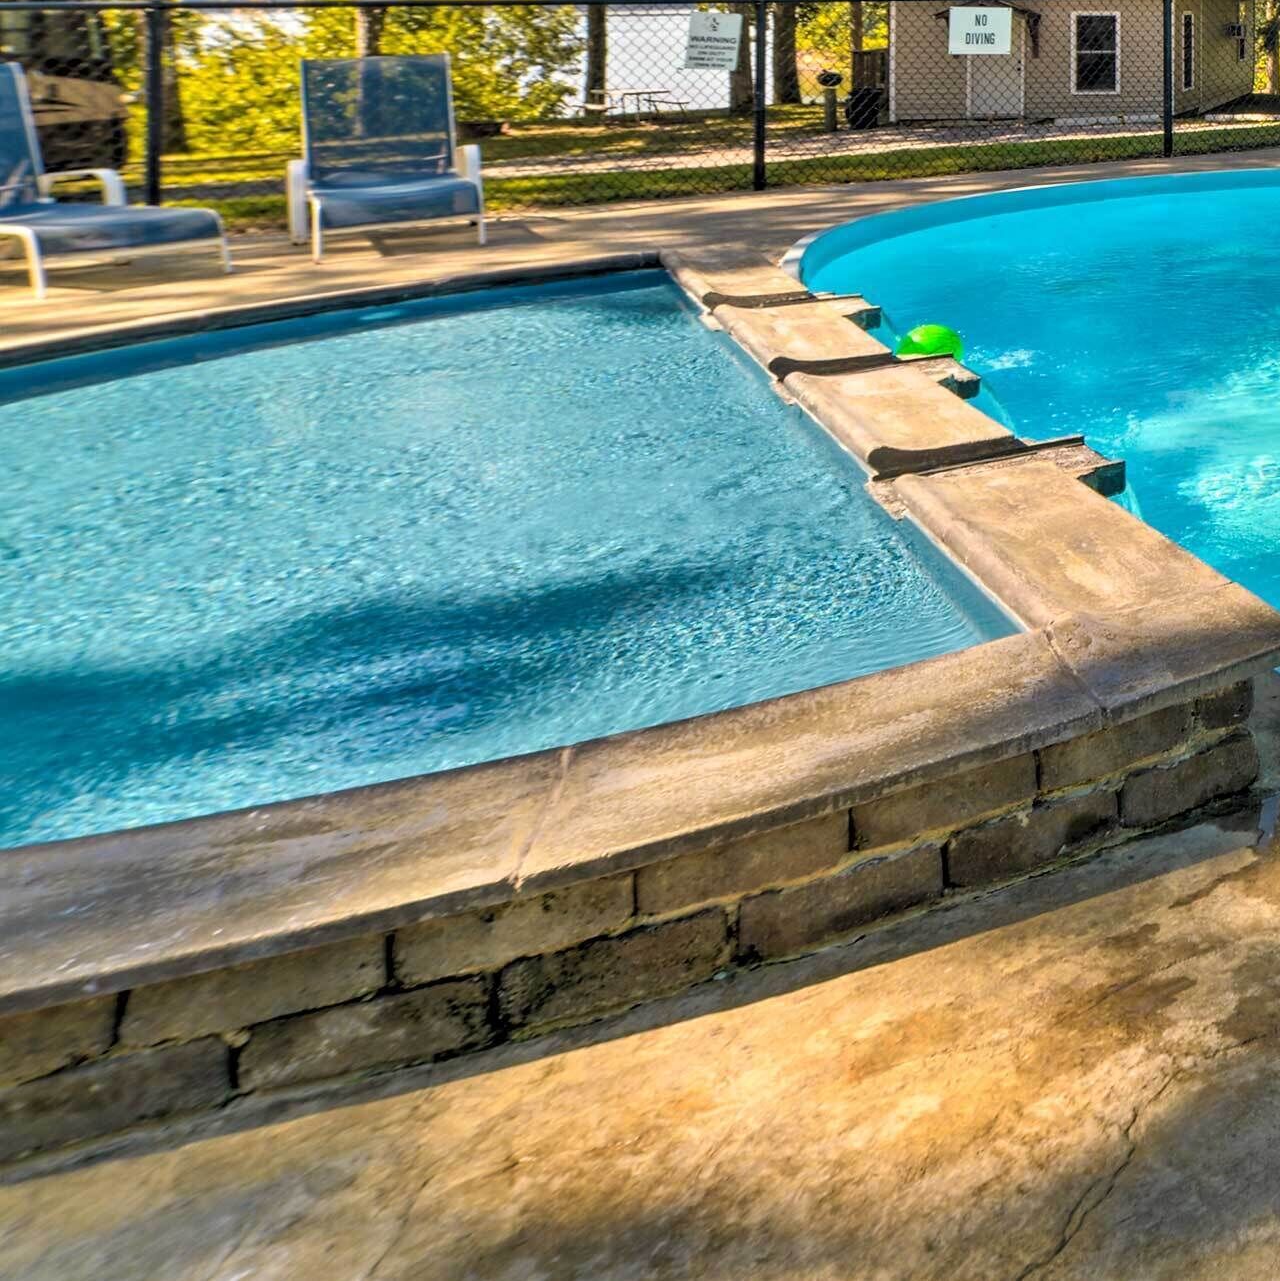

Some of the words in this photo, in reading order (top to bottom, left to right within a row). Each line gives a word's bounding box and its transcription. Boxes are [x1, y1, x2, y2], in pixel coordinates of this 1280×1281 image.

[975, 14, 988, 27] NO
[690, 36, 737, 44] WARNING
[965, 32, 996, 45] DIVING
